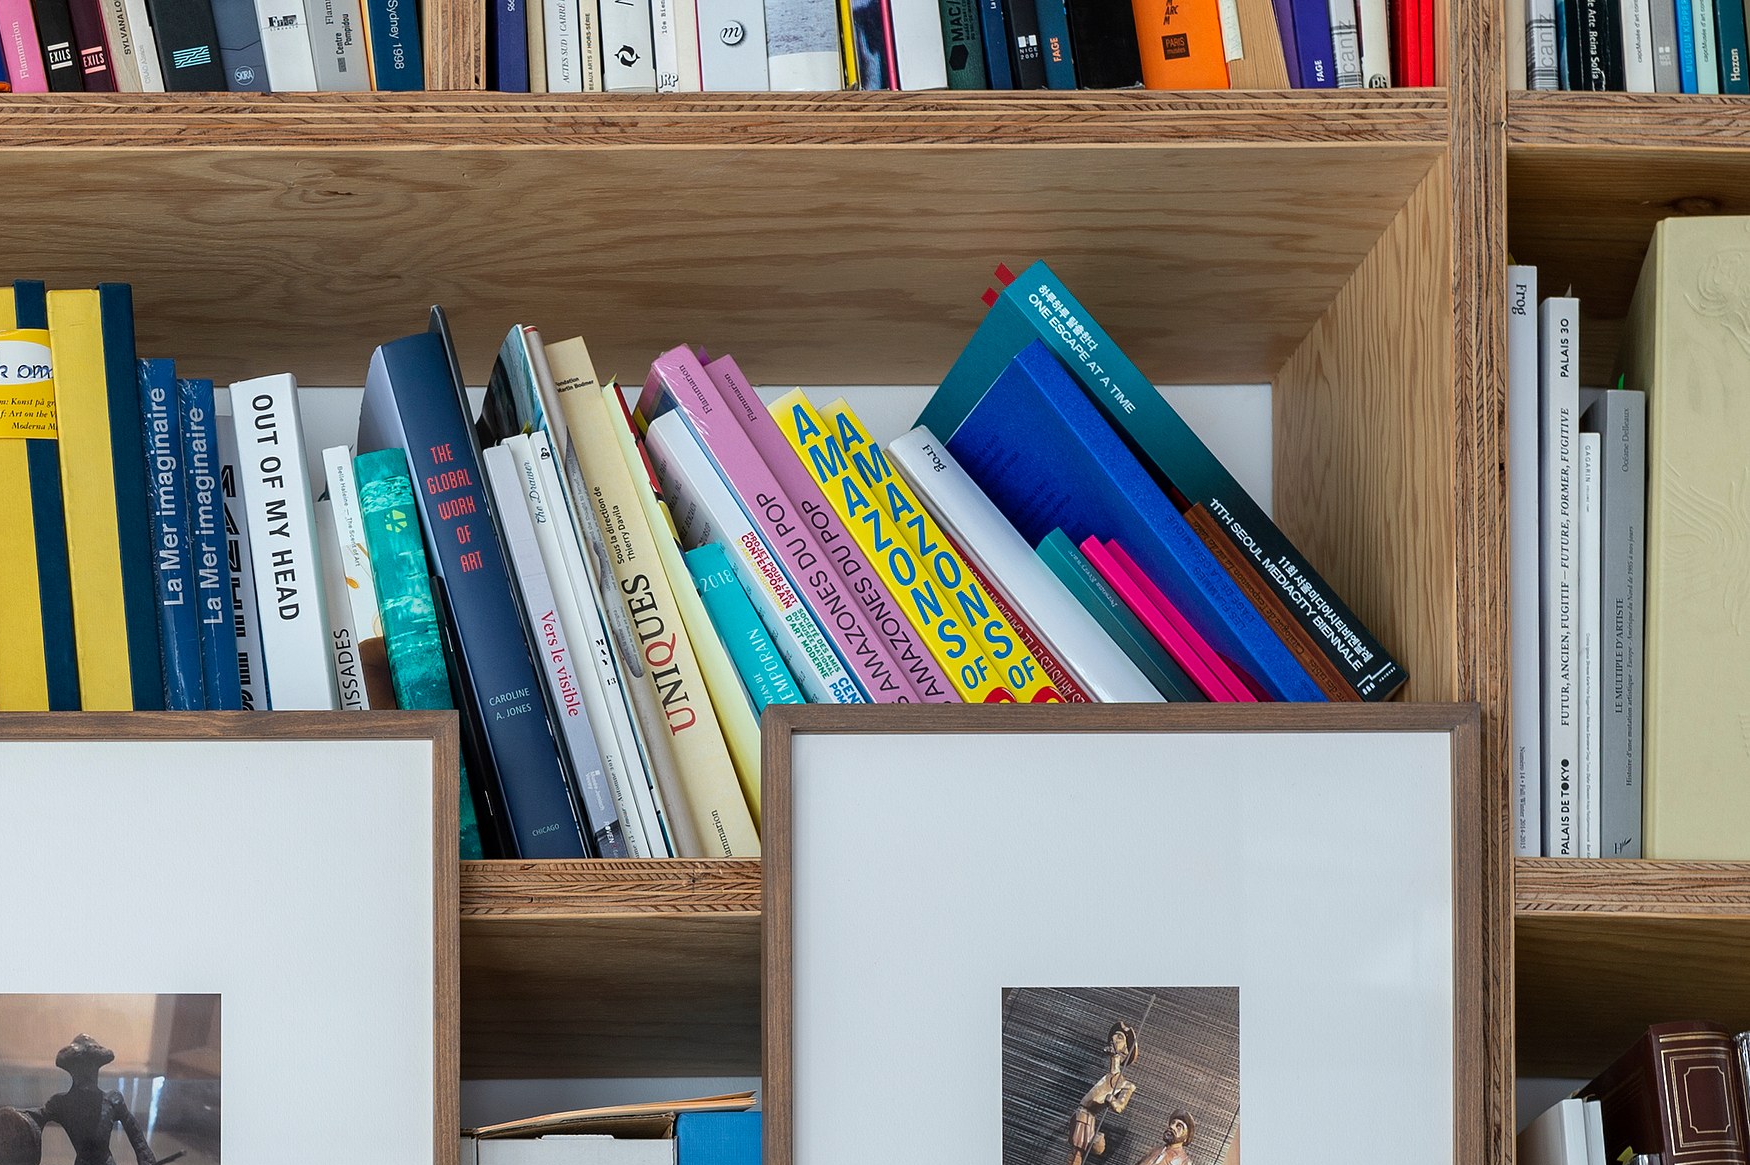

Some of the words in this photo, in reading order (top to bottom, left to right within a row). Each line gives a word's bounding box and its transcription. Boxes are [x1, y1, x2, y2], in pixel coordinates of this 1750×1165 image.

[343, 13, 351, 46] Pompidou
[388, 0, 401, 40] Sydney
[13, 21, 29, 79] Flammarion
[49, 48, 71, 64] EXILS
[336, 32, 344, 54] Centre
[394, 44, 404, 69] 1998
[1050, 37, 1060, 62] FAGE
[83, 52, 105, 67] EXILS
[1731, 48, 1740, 81] Hazan
[1561, 319, 1569, 334] 30
[1028, 294, 1052, 319] ONE
[1049, 318, 1089, 362] ESCAPE
[1086, 360, 1104, 376] AT
[1100, 375, 1111, 387] A
[1110, 384, 1136, 414] TIME
[1561, 339, 1570, 378] PALAIS
[252, 394, 279, 445] OUT
[147, 388, 176, 521] imaginaire
[430, 444, 454, 463] THE
[922, 444, 947, 473] Frog
[260, 457, 283, 489] OF
[426, 470, 473, 494] GLOBAL
[265, 499, 290, 539] MY
[437, 497, 475, 520] WORK
[456, 527, 472, 545] OF
[160, 523, 180, 577] Mer
[460, 551, 483, 572] ART
[164, 579, 184, 606] La
[273, 551, 300, 621] HEAD
[699, 570, 734, 593] 2018
[540, 610, 558, 648] Vers
[551, 648, 564, 664] le
[962, 656, 988, 689] OF
[489, 687, 531, 707] CAROLINE
[556, 665, 580, 718] visible
[506, 703, 532, 719] JONES
[532, 822, 560, 837] CHICAGO
